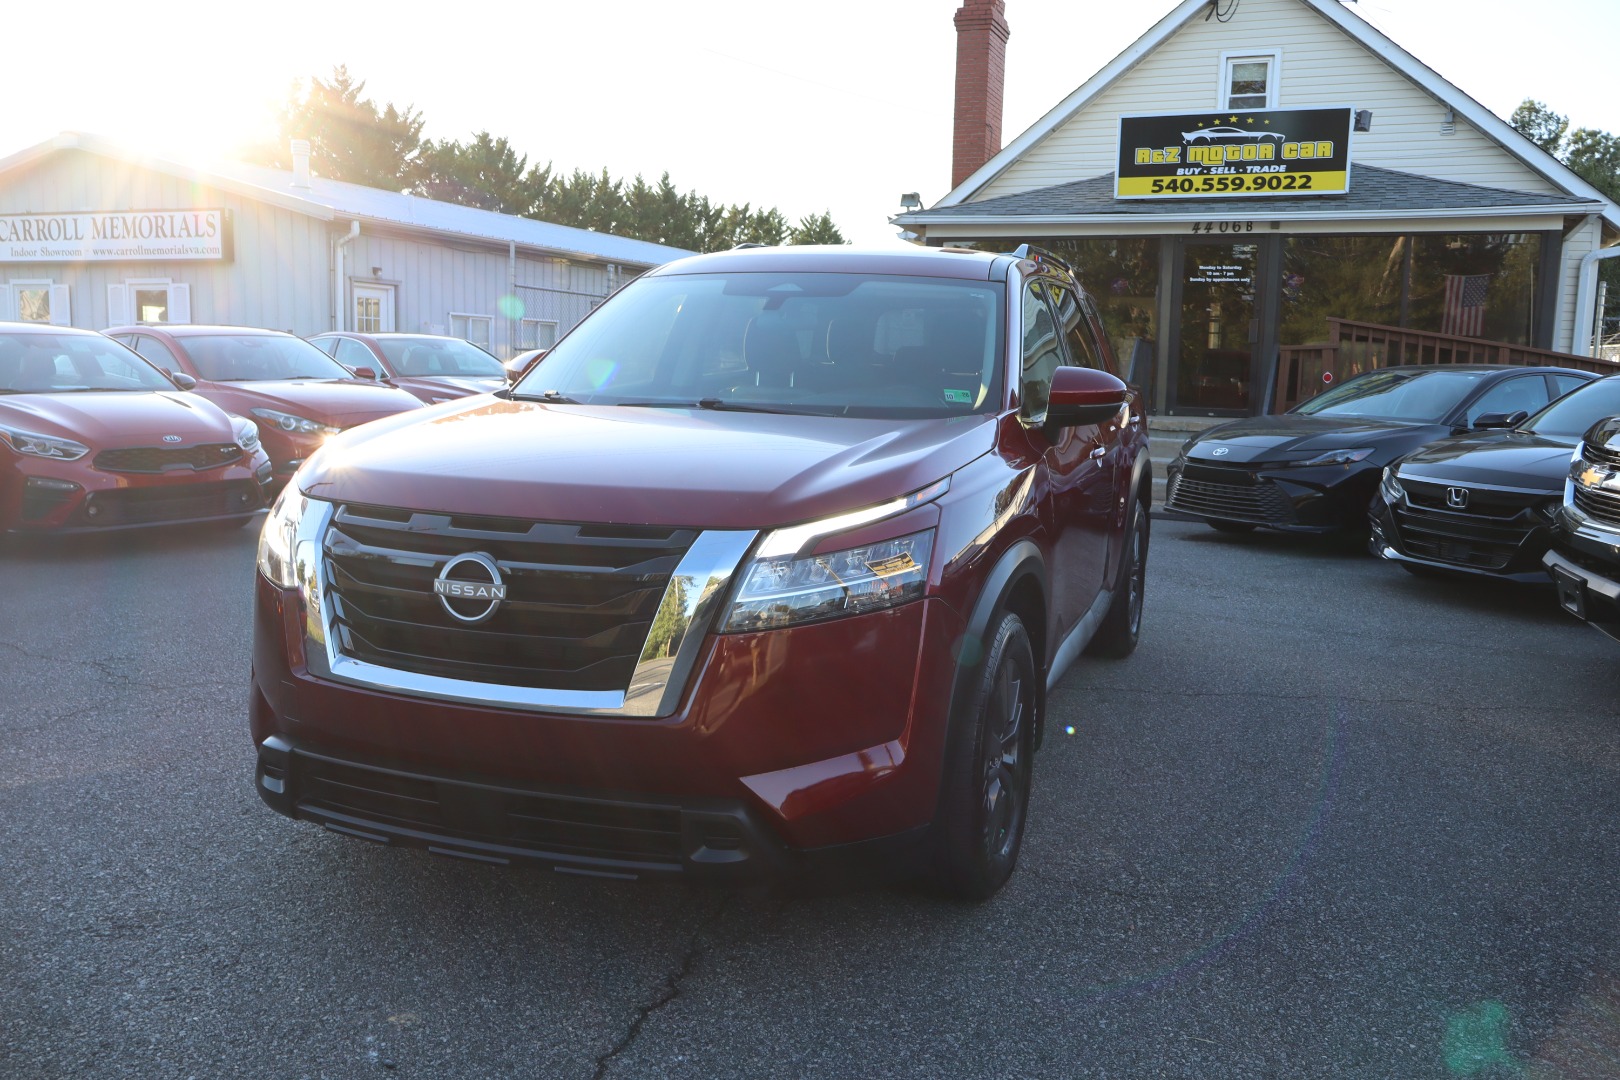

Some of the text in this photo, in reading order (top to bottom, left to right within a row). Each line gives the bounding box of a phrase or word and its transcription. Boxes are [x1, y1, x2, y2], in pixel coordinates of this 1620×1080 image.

[1176, 165, 1287, 176] BUY SELL TRADE
[1151, 174, 1313, 194] 540.559.9022
[0, 213, 216, 242] CARROLL MEMORIALS
[10, 244, 220, 257] Indoor Showroom www.carrollmemorialsva.com
[435, 581, 504, 598] NISSAN
